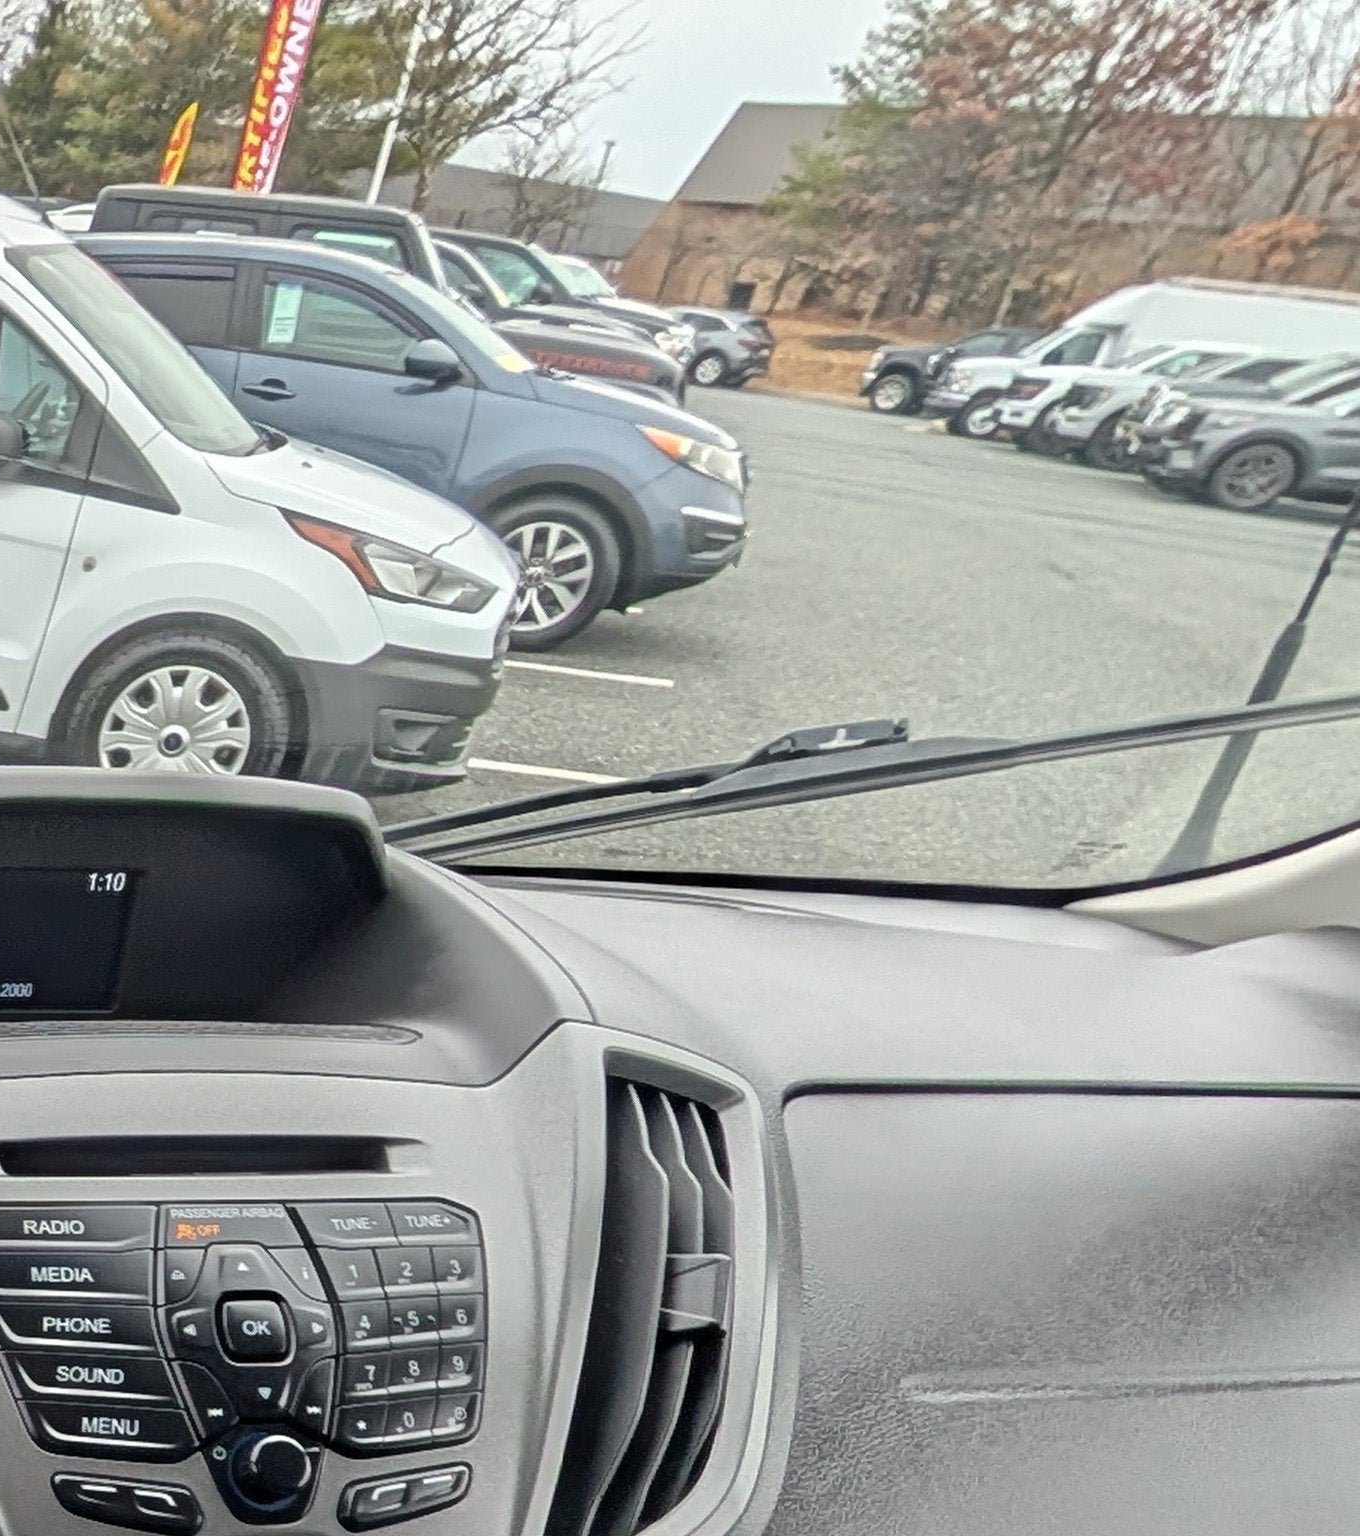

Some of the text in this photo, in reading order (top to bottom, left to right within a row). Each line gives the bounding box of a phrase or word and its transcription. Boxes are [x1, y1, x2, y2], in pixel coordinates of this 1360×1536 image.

[88, 872, 126, 892] 1:10
[170, 1206, 285, 1219] PASSENGER AIRBAG
[404, 1213, 451, 1228] TUNE+
[22, 1219, 85, 1236] RADIO
[196, 1223, 221, 1237] OFF
[30, 1266, 95, 1284] MEDIA
[348, 1264, 359, 1279] 1
[399, 1261, 413, 1277] 2
[449, 1259, 462, 1274] 3
[358, 1315, 371, 1330] 4
[407, 1310, 420, 1327] 5
[456, 1308, 468, 1324] 6
[41, 1316, 112, 1334] PHONE
[241, 1319, 272, 1336] OK
[407, 1359, 421, 1376] 8
[452, 1355, 465, 1372] 9
[54, 1365, 125, 1385] SOUND
[363, 1364, 376, 1382] 7
[81, 1416, 140, 1436] MENU
[402, 1411, 415, 1428] 0
